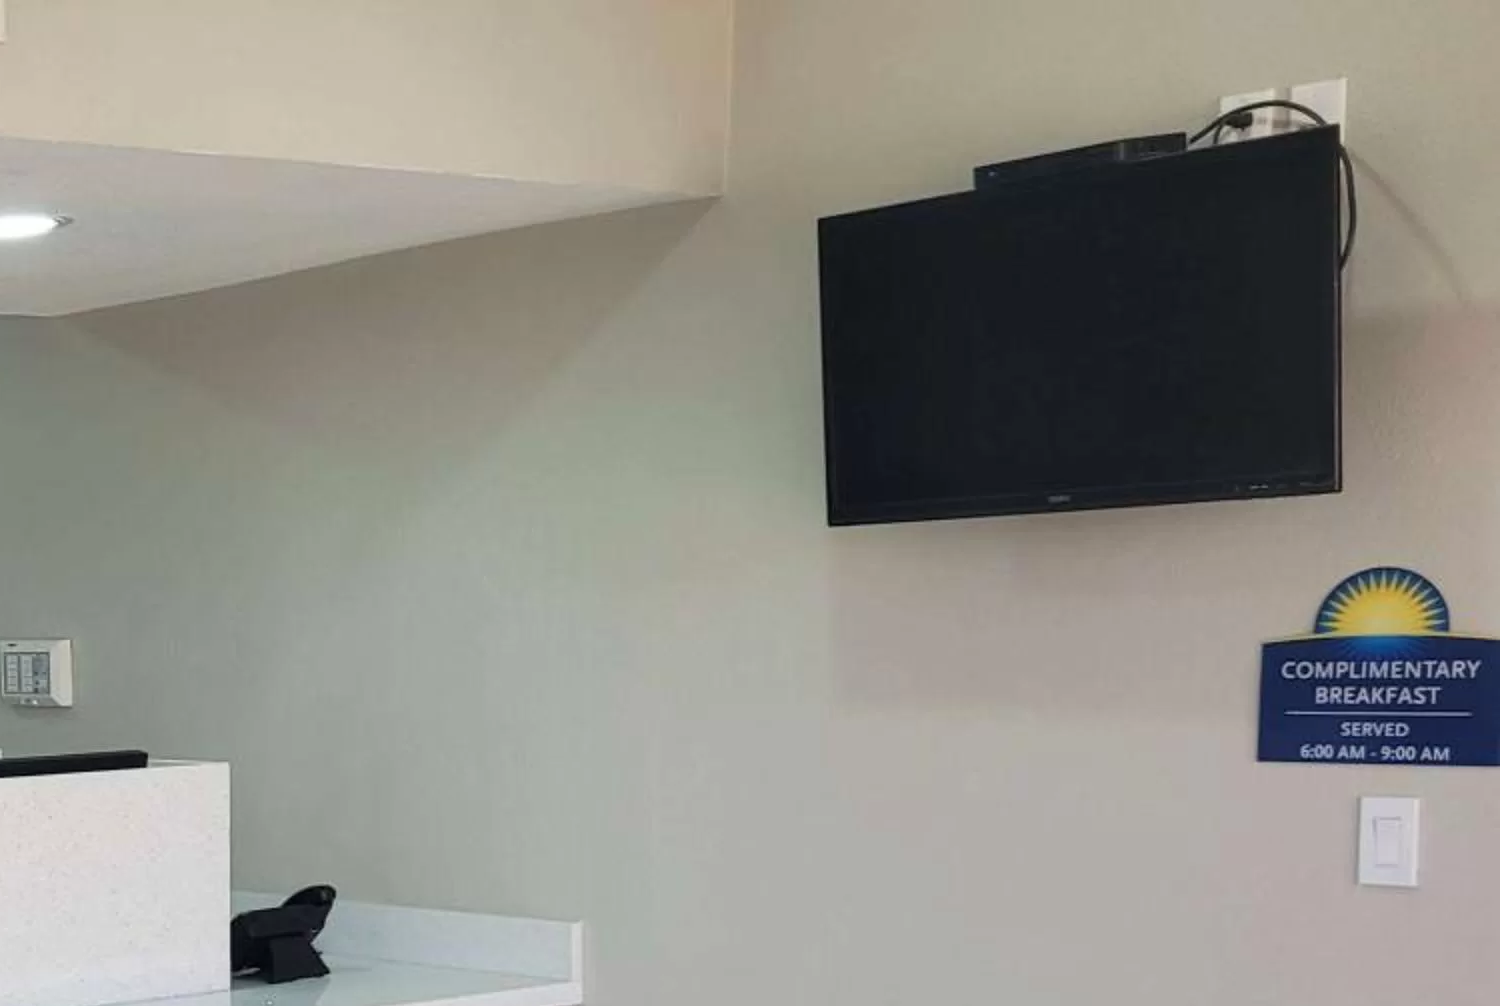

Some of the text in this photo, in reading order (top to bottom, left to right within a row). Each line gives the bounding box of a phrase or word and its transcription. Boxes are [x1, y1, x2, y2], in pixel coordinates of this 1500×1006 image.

[1281, 660, 1482, 680] COMPLIMENTARY
[1315, 686, 1442, 705] BREAKFAST
[1340, 722, 1410, 737] SERVED
[1300, 744, 1334, 759] 6:00
[1337, 745, 1365, 759] AM
[1380, 745, 1417, 761] 9:00
[1420, 747, 1450, 761] AM
